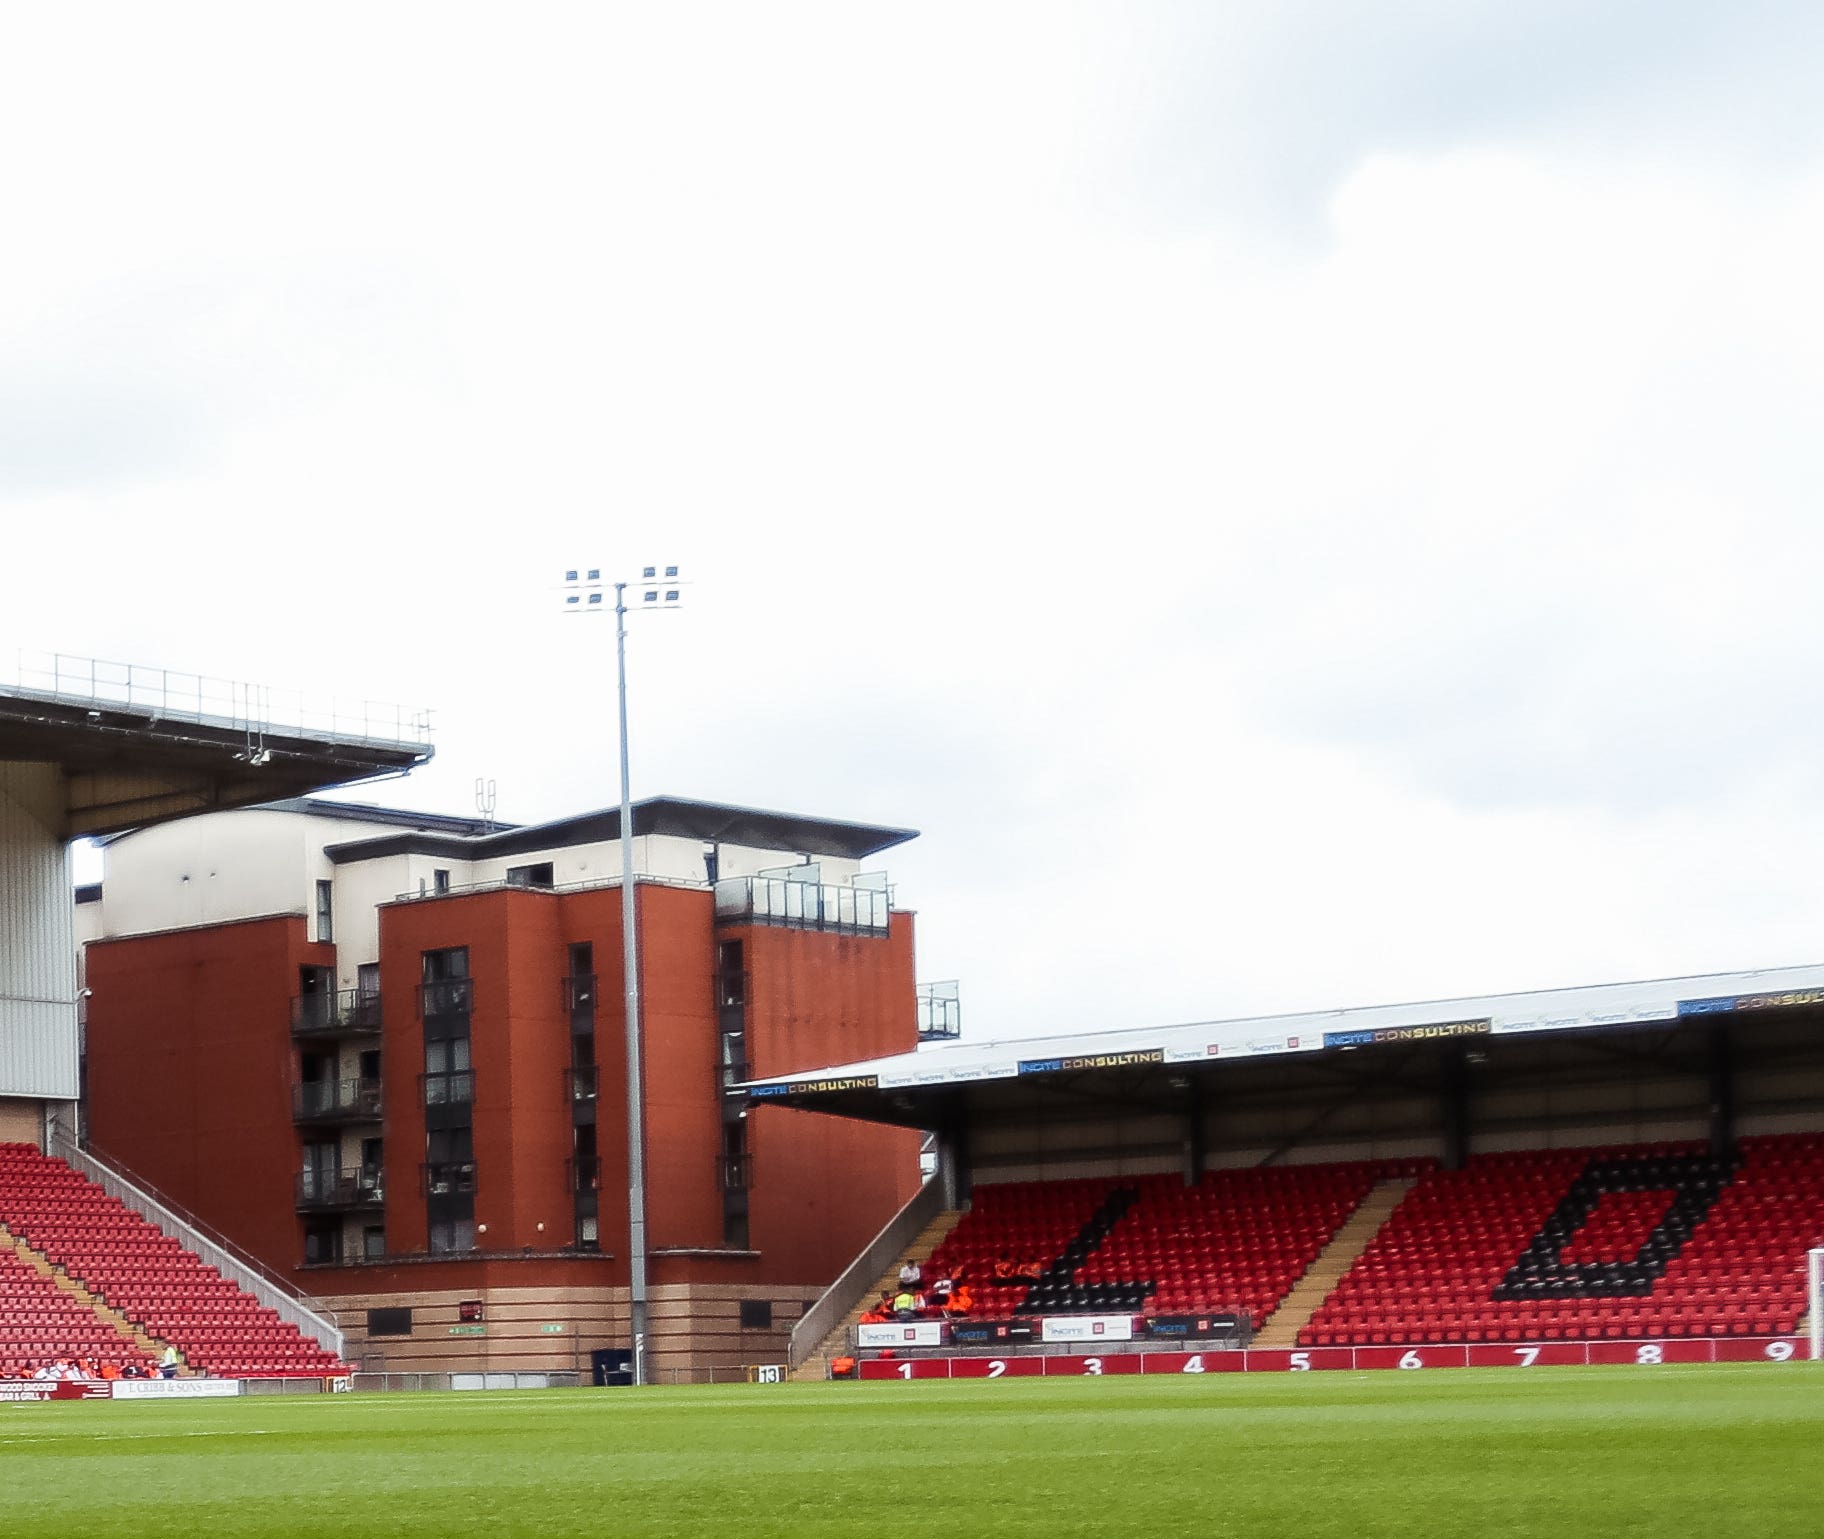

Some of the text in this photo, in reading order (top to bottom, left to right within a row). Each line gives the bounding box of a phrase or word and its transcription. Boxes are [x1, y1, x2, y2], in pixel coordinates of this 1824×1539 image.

[1374, 1022, 1490, 1042] CONSULTING
[1062, 1052, 1163, 1070] CONSULTING
[788, 1077, 877, 1094] CONSULTING
[1398, 1350, 1423, 1370] 6
[1513, 1347, 1541, 1367] 7
[1636, 1344, 1662, 1364] 8
[1765, 1341, 1795, 1361] 9
[898, 1363, 912, 1379] 1
[988, 1361, 1006, 1378] 2
[1083, 1358, 1102, 1376] 3
[1182, 1355, 1205, 1374] 4
[1289, 1352, 1311, 1372] 5
[761, 1368, 777, 1383] 13
[334, 1379, 347, 1393] 12
